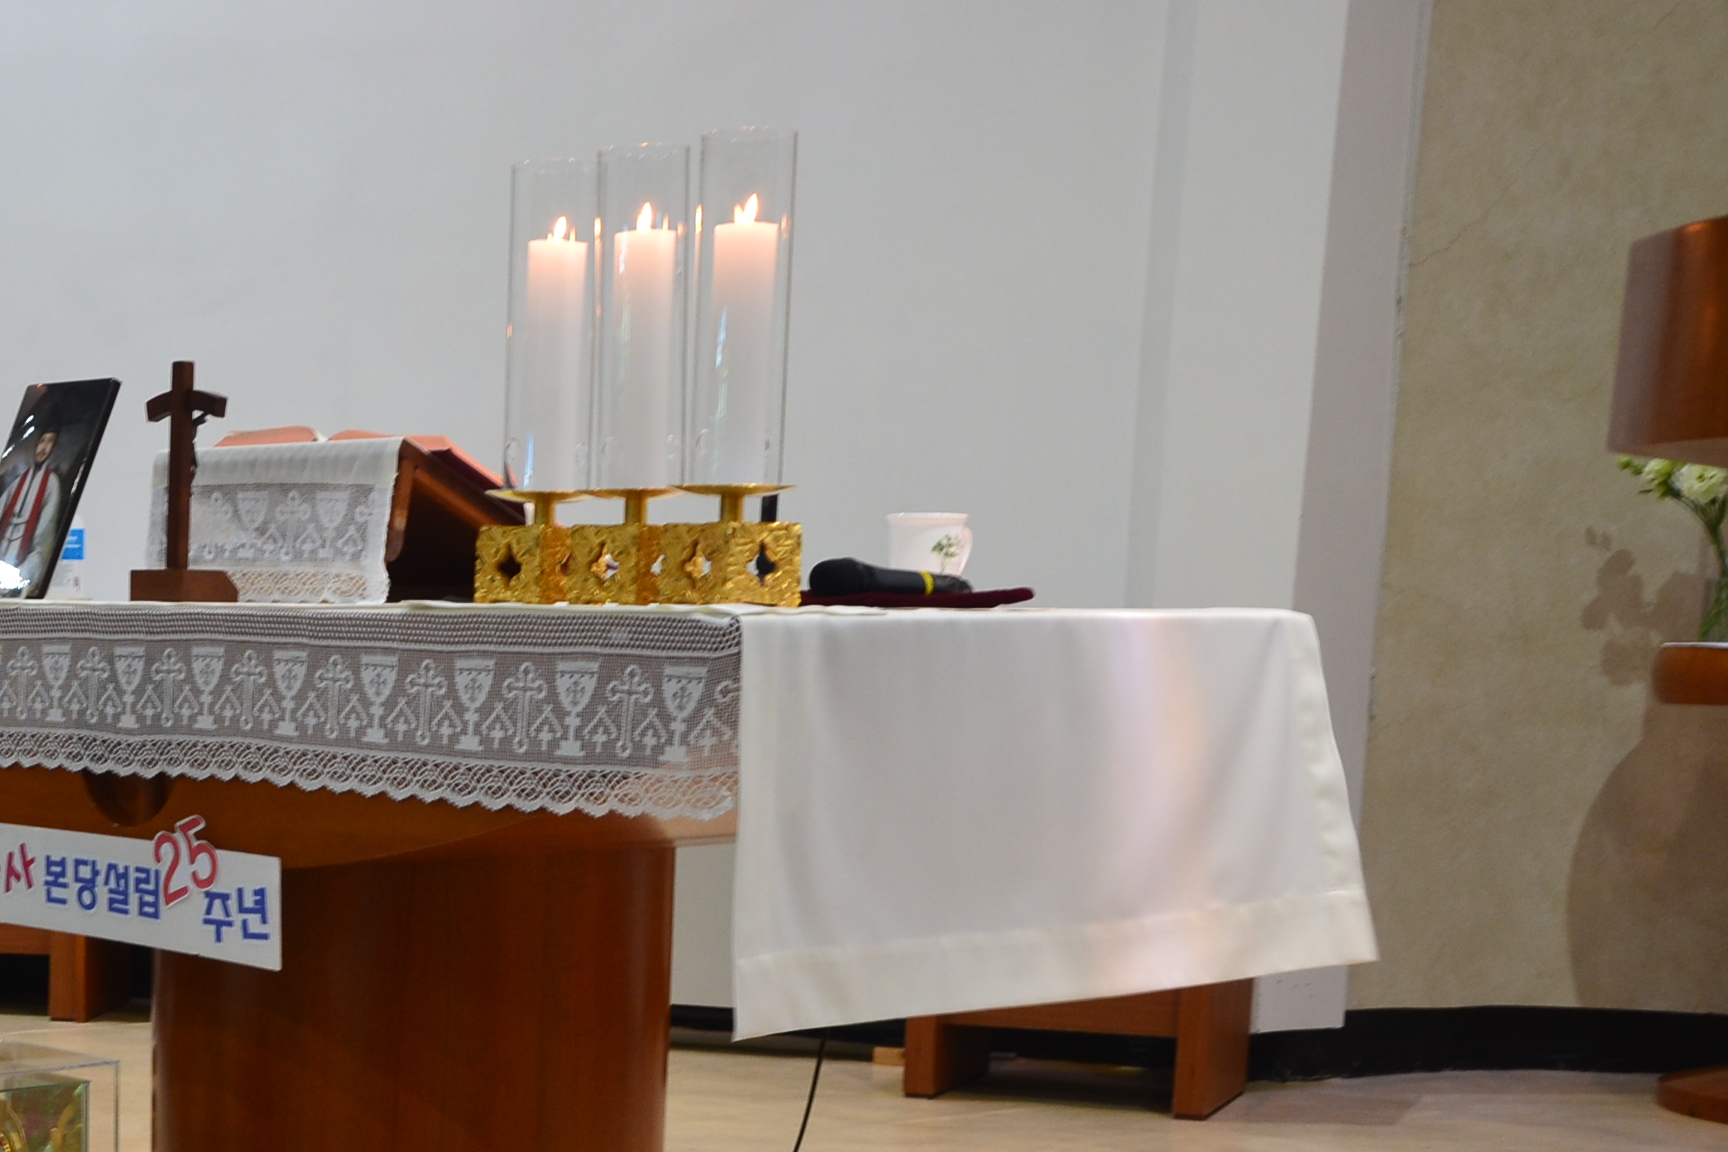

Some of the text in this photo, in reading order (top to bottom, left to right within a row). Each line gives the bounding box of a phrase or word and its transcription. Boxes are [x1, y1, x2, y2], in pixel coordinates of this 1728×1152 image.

[43, 854, 162, 920] 본당설립
[153, 814, 219, 907] 25
[202, 887, 271, 943] 주년
